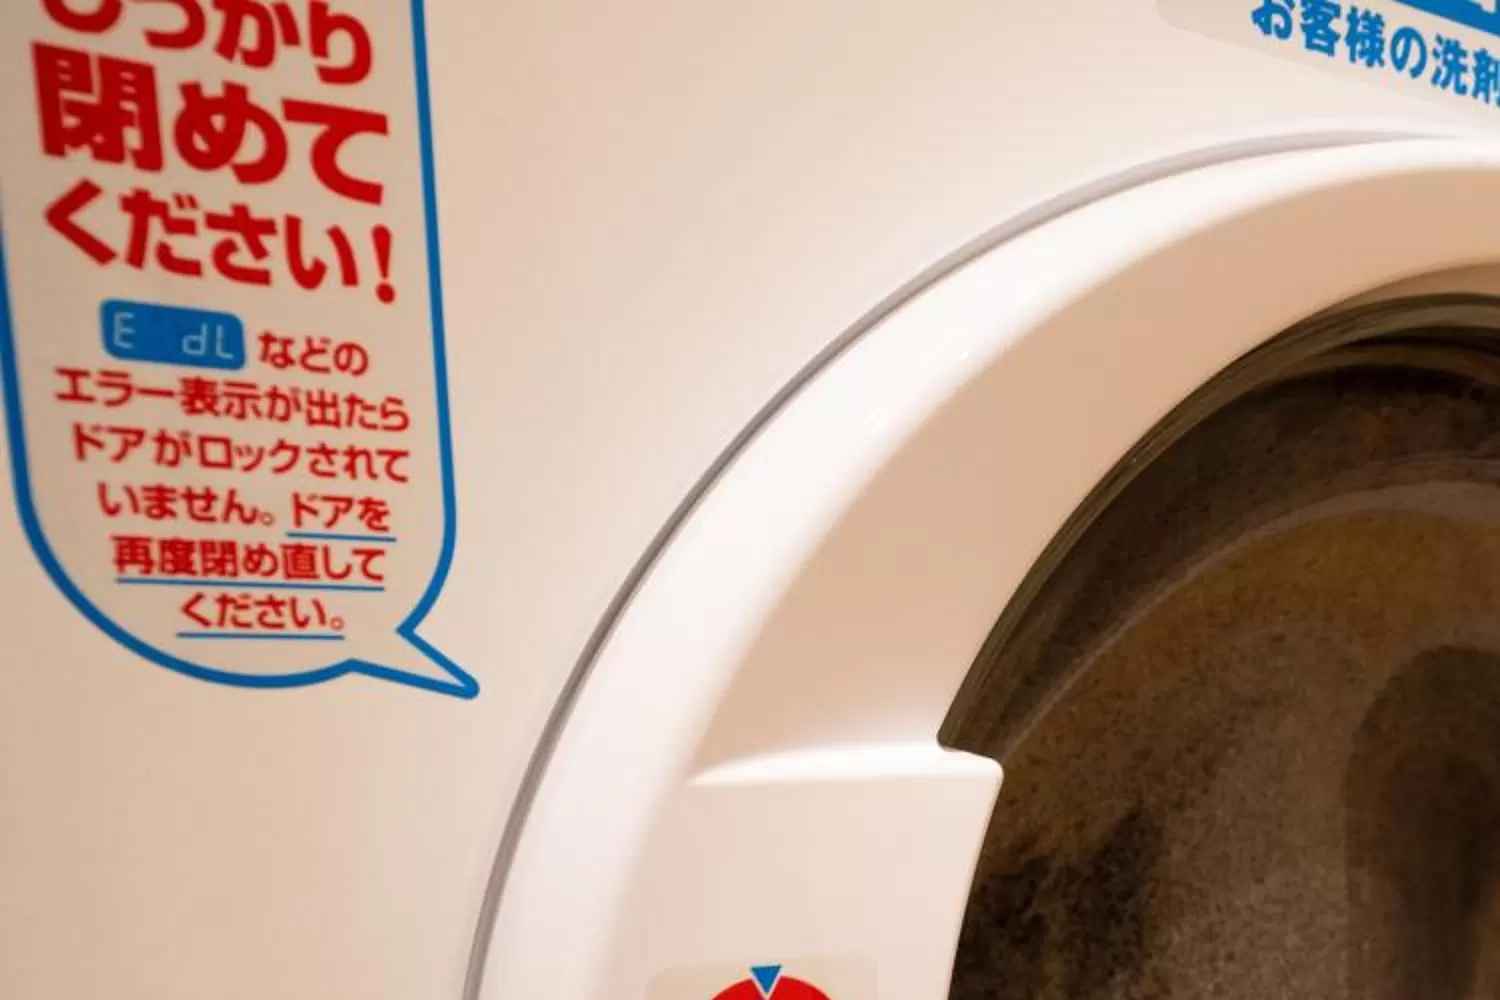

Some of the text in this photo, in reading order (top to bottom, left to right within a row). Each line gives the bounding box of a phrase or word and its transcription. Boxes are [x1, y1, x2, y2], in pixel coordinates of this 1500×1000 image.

[32, 41, 390, 205] 閉めて
[45, 179, 396, 304] ください!
[258, 331, 369, 376] などの
[56, 367, 411, 433] エラー表示が出たら
[73, 422, 409, 483] ドアがロックされて
[111, 534, 385, 582] 再度閉め直して
[182, 592, 344, 631] ください。
